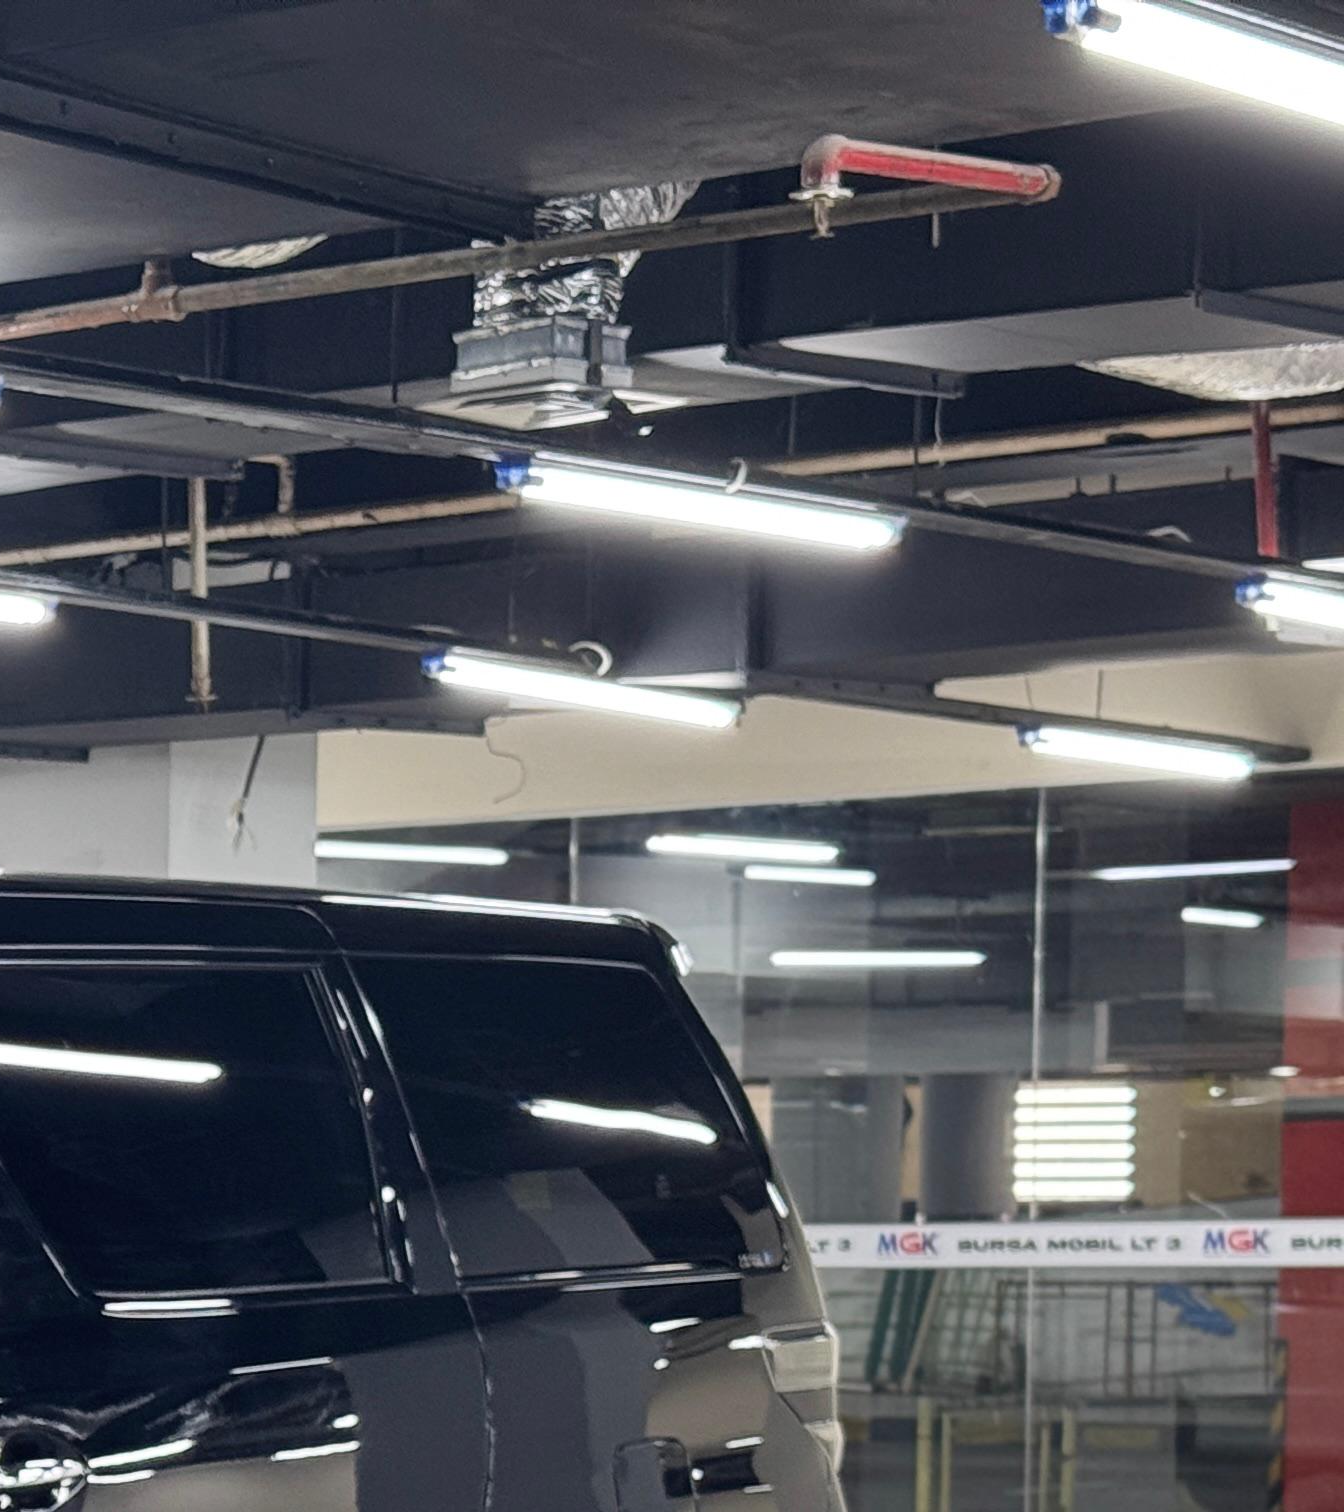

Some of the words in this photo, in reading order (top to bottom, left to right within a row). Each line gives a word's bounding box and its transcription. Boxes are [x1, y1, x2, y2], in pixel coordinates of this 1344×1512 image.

[877, 1231, 938, 1256] MGK
[957, 1239, 1038, 1253] BURSA
[1047, 1238, 1123, 1252] MOBIL
[1130, 1237, 1158, 1251] LT
[1203, 1229, 1271, 1254] MGK
